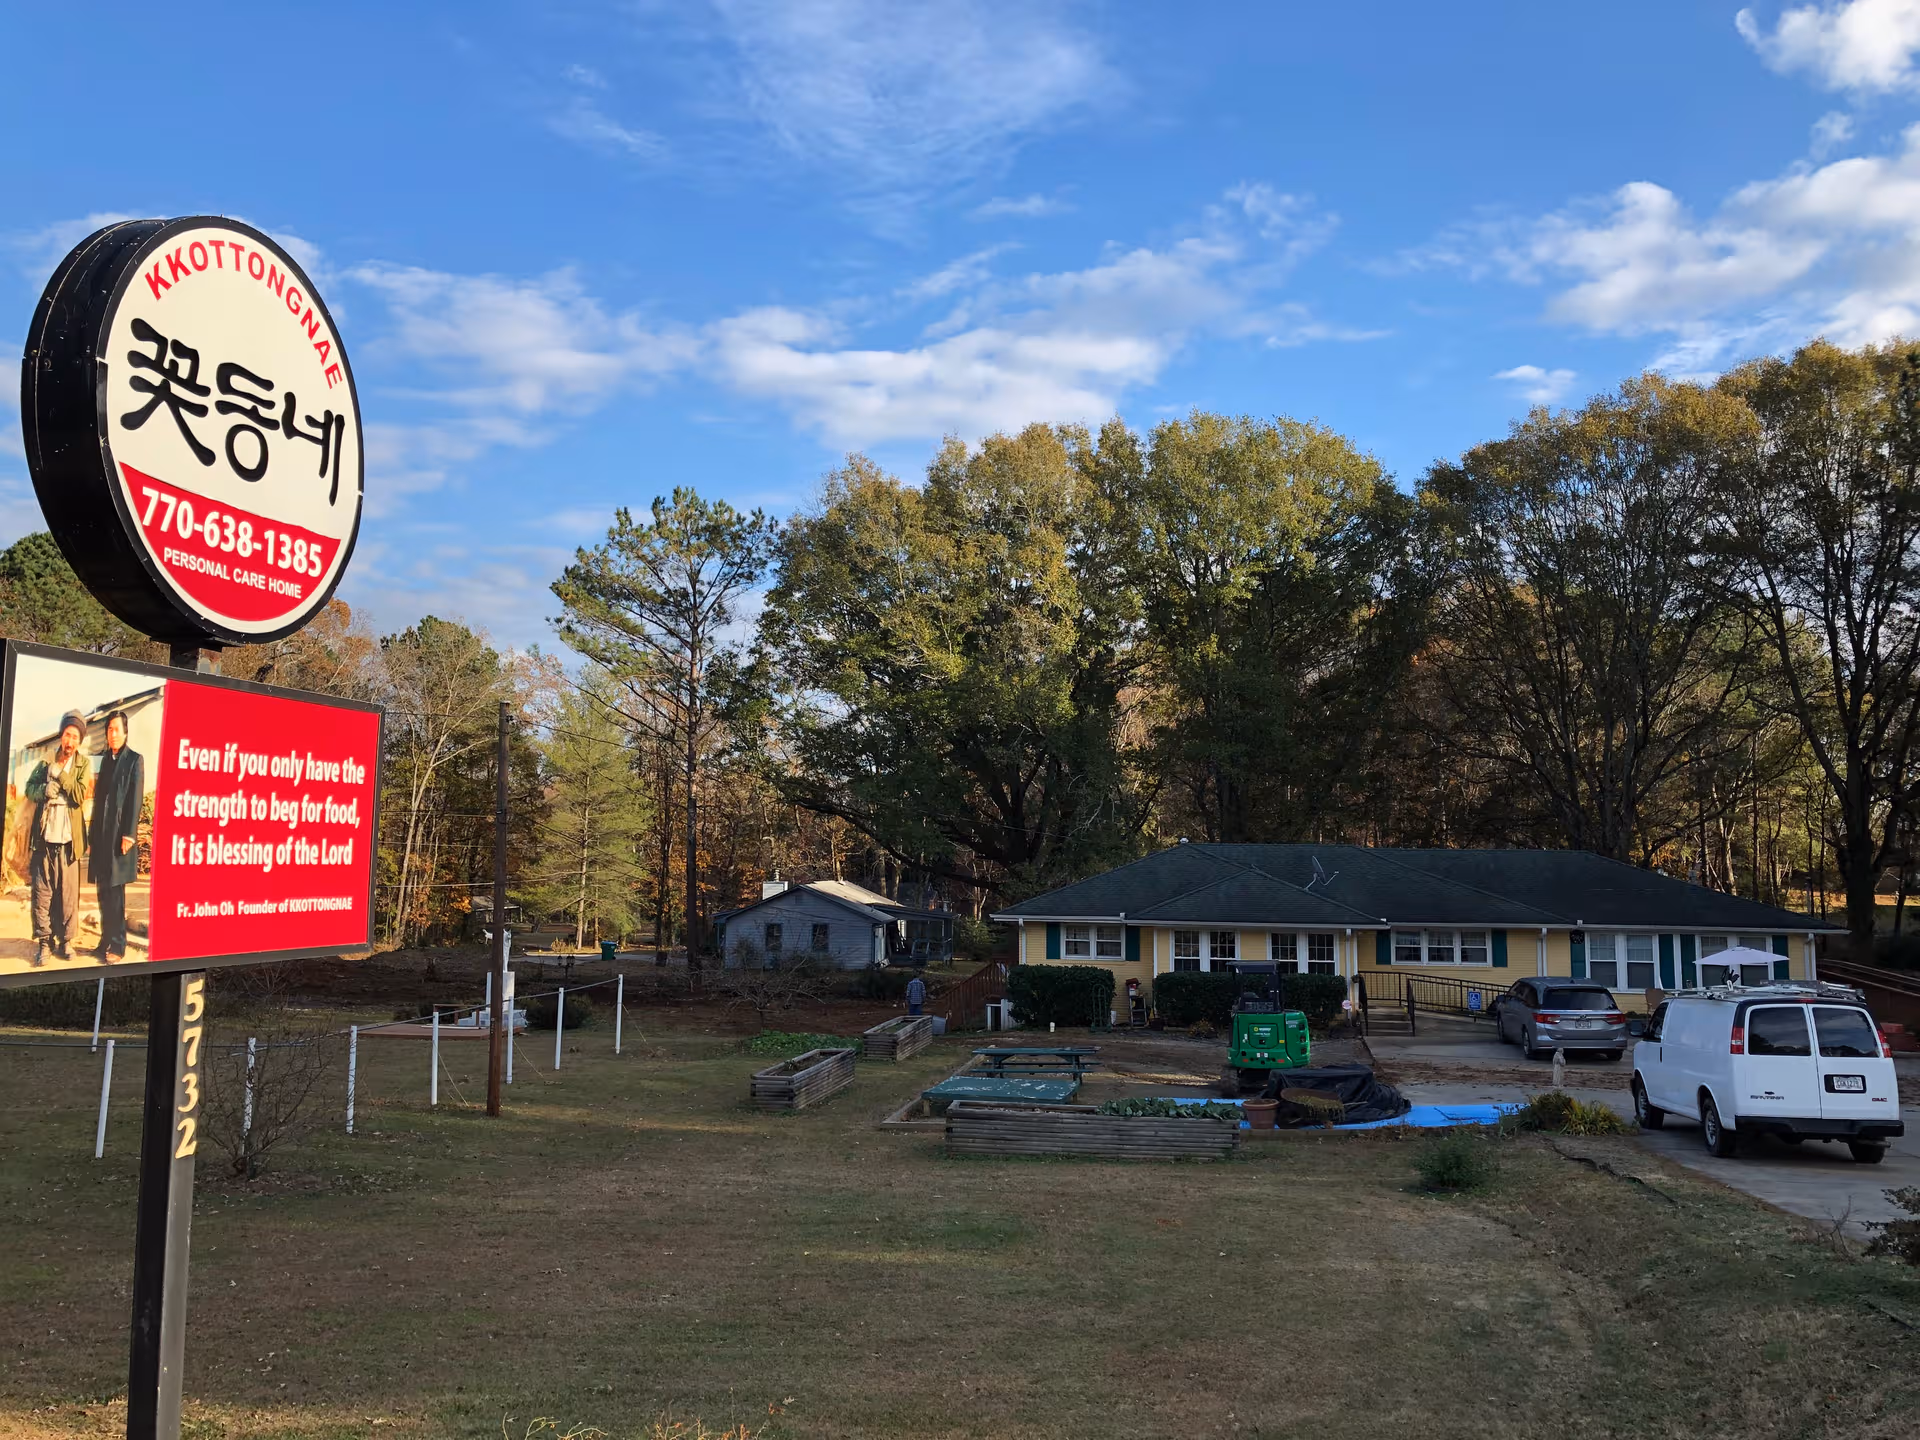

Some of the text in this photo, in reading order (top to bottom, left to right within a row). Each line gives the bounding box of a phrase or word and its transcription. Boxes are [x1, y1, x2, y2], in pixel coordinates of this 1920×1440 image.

[145, 239, 343, 390] KKOTTONGNAE
[120, 317, 346, 507] 꽃동네
[142, 486, 322, 578] 770-638-1385
[164, 546, 302, 599] PERSONAL CARE HOME
[178, 738, 366, 787] Even if you only have the
[173, 789, 361, 830] strength to beg for food,
[171, 833, 354, 873] It is blessing of the Lord
[177, 896, 353, 918] Fr. John Oh Founder of KKOTTONGNAE
[175, 978, 205, 1160] 5732
